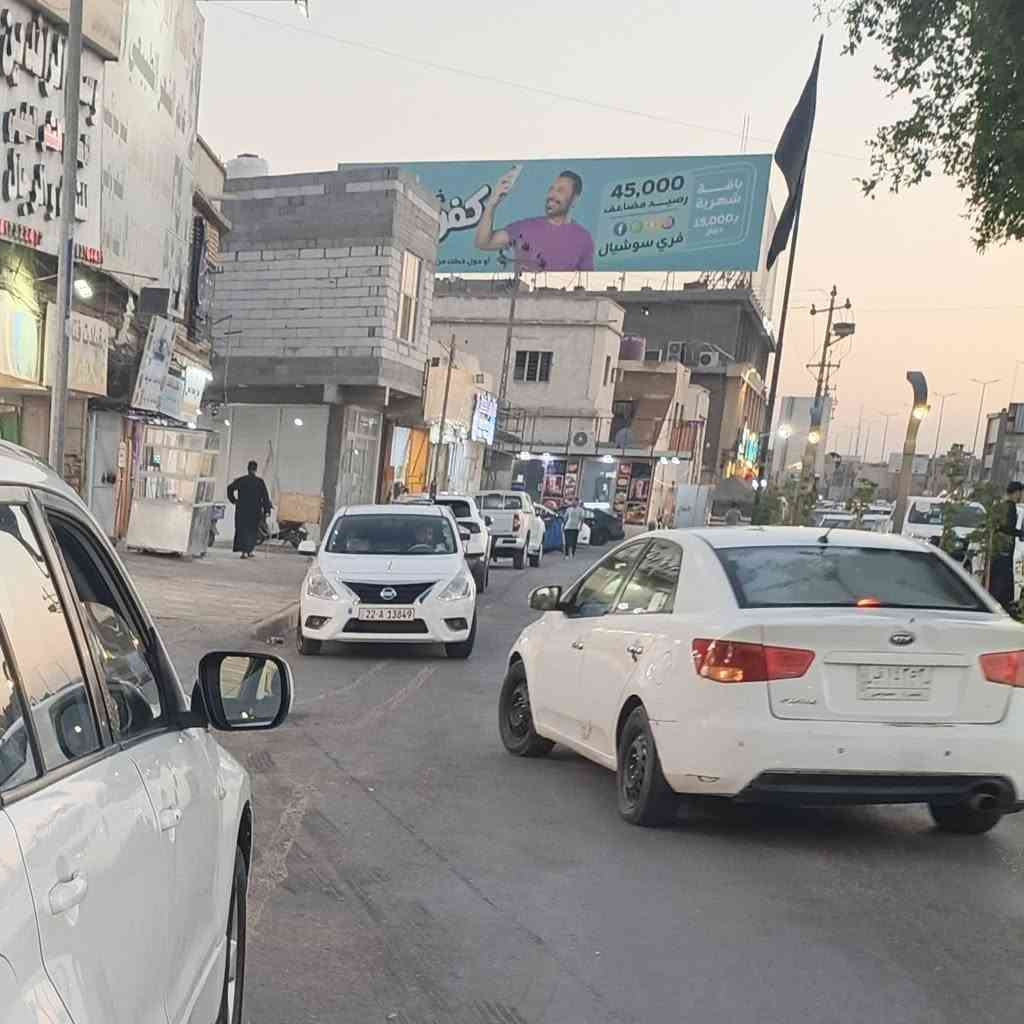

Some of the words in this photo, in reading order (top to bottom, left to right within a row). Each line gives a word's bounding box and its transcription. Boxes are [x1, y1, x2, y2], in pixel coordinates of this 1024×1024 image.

[610, 175, 685, 199] 45,000
[603, 199, 646, 214] مضاعف
[648, 194, 689, 209] رصيد
[598, 235, 654, 257] سوشيال
[656, 231, 685, 252] فري
